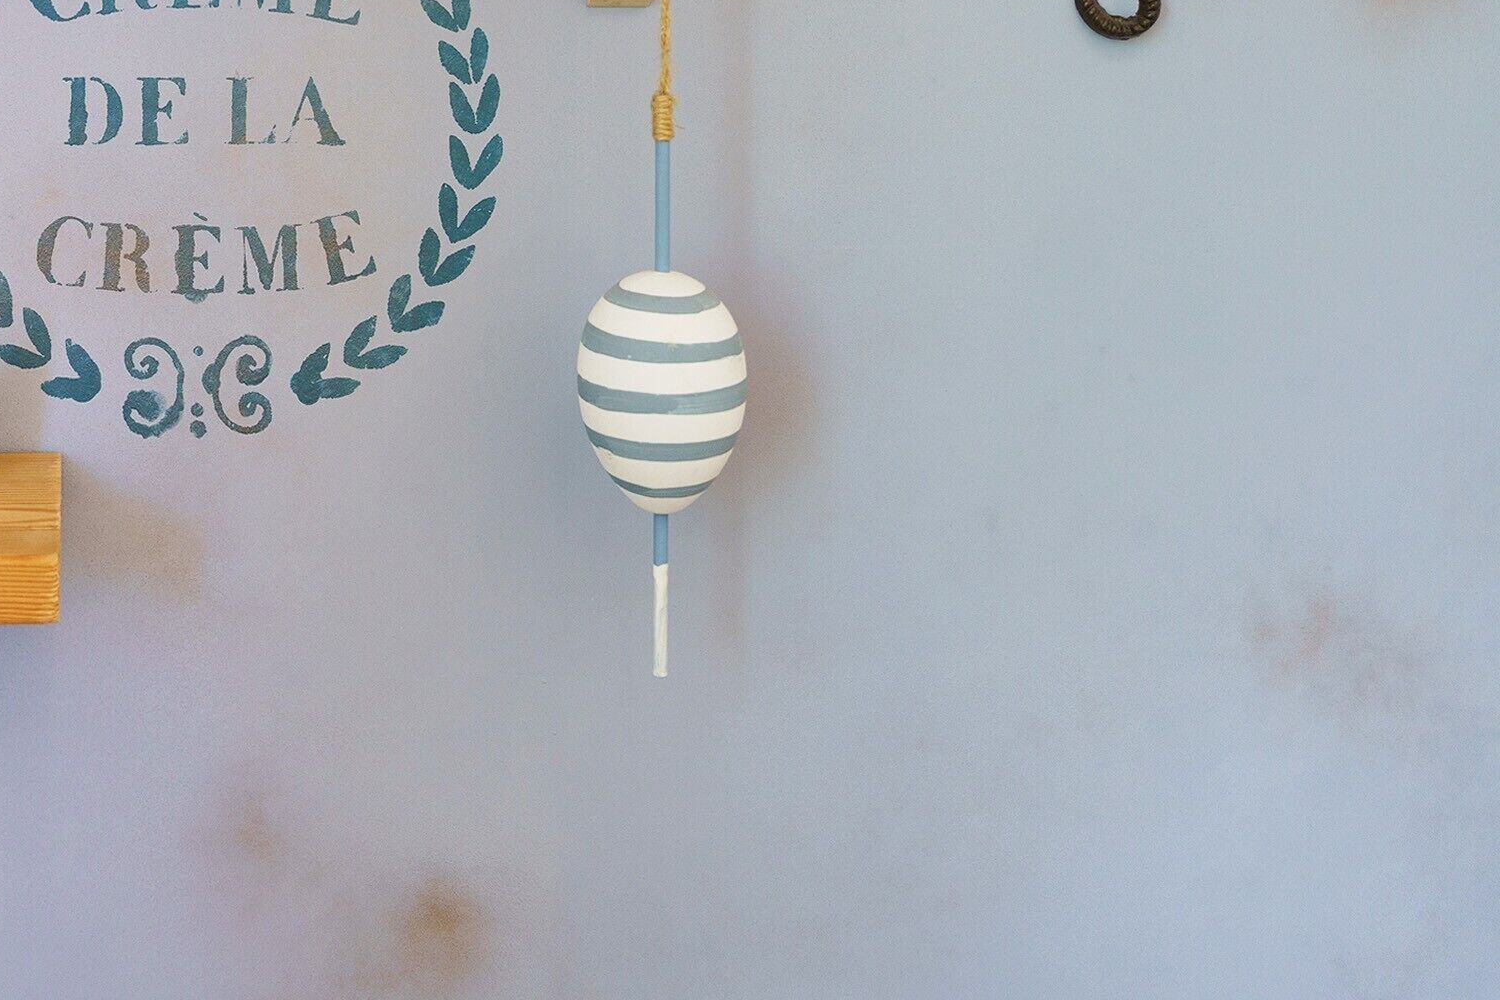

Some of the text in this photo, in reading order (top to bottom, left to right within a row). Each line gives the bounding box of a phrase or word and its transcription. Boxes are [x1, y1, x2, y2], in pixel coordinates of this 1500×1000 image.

[63, 73, 346, 146] DE LA
[36, 211, 377, 297] CRÈME
